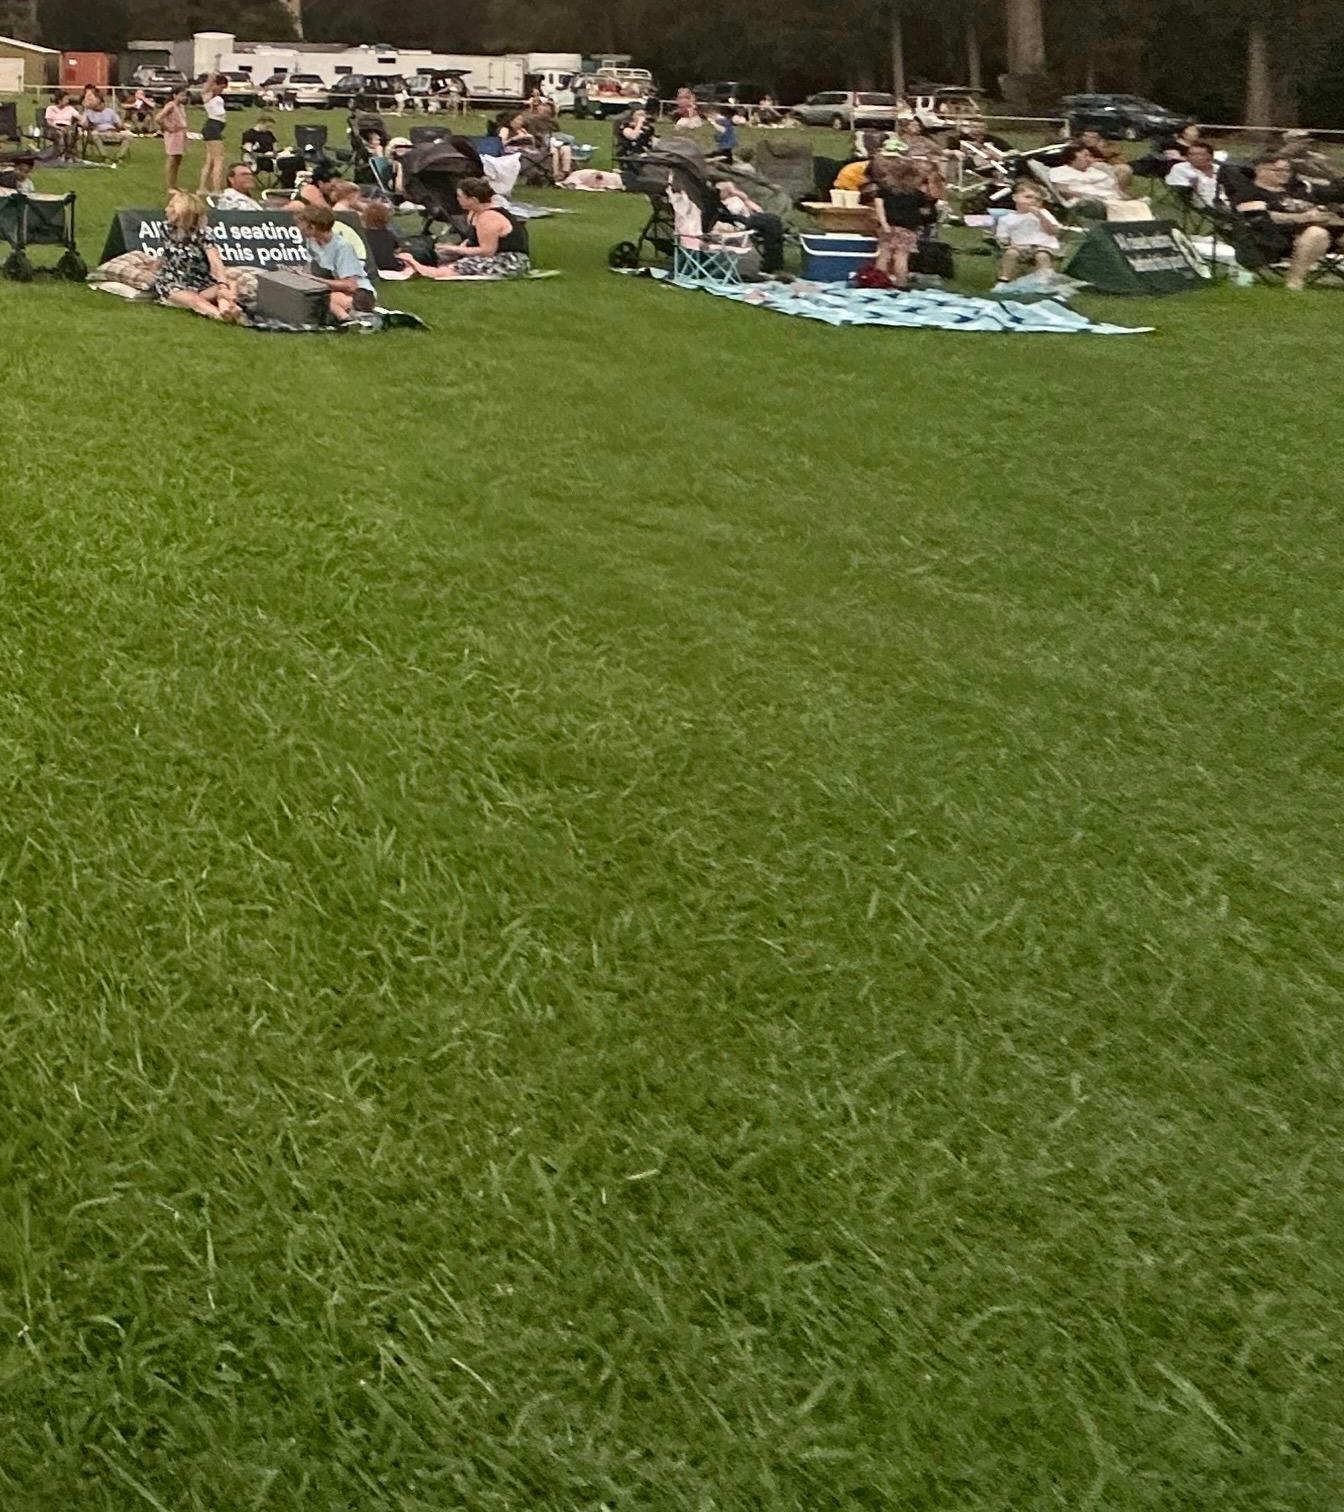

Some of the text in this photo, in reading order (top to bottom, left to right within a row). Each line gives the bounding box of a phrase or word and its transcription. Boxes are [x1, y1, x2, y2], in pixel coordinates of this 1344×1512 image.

[230, 221, 303, 244] seating
[217, 243, 312, 266] this point
